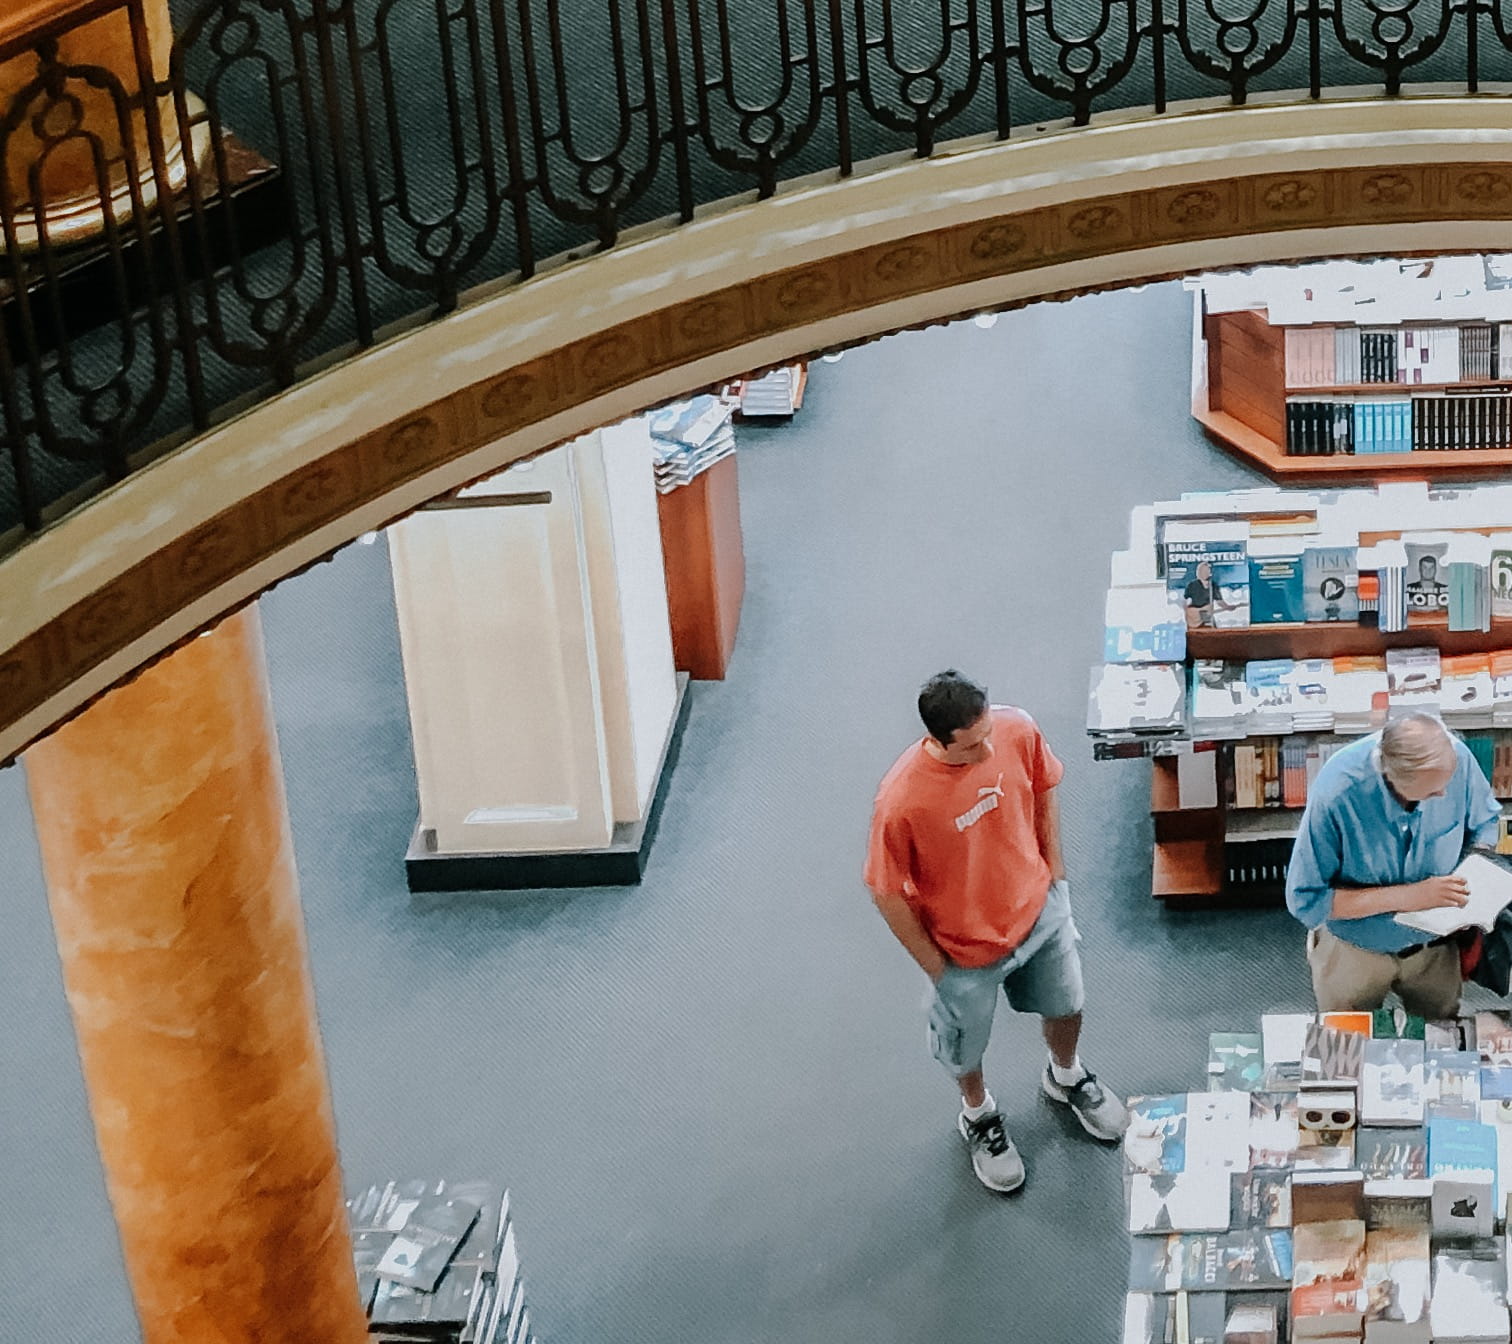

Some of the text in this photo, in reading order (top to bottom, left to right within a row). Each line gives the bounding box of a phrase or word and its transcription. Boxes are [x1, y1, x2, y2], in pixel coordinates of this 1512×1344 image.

[1168, 543, 1207, 553] BRUCE
[1168, 552, 1246, 563] SPRINGSTEEN
[1406, 593, 1449, 606] LOBO
